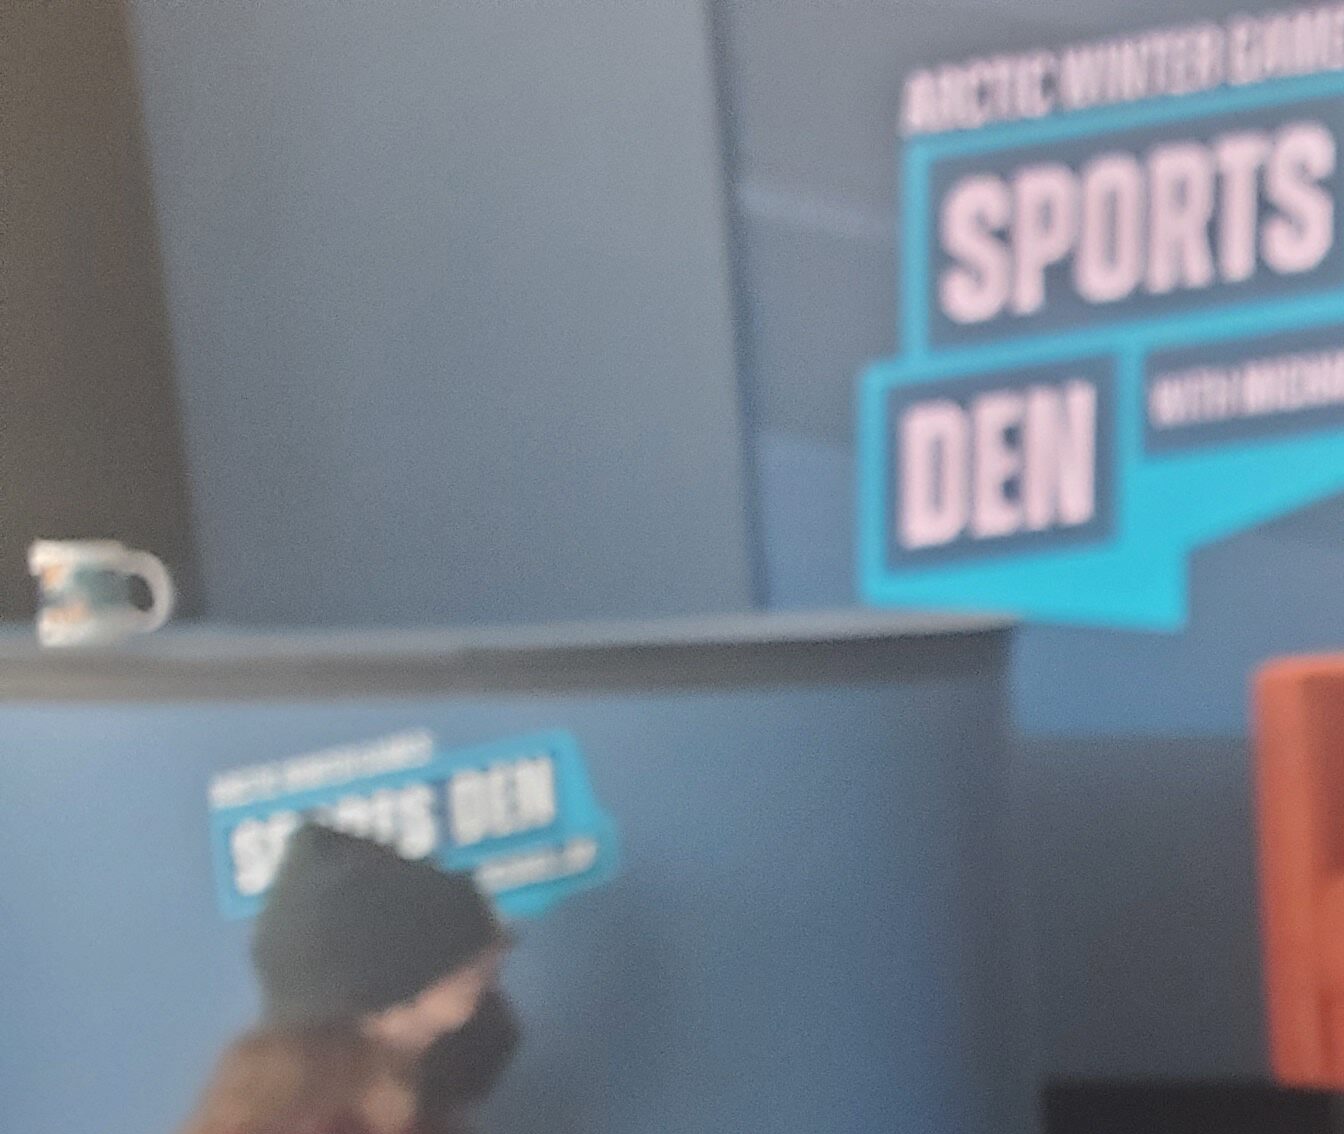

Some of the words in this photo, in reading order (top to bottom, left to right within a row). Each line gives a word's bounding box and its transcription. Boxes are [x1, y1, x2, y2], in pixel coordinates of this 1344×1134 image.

[904, 50, 1060, 134] ARCTIC
[1058, 22, 1227, 107] WINTER
[938, 120, 1336, 323] SPORTS
[900, 379, 1097, 550] DEN
